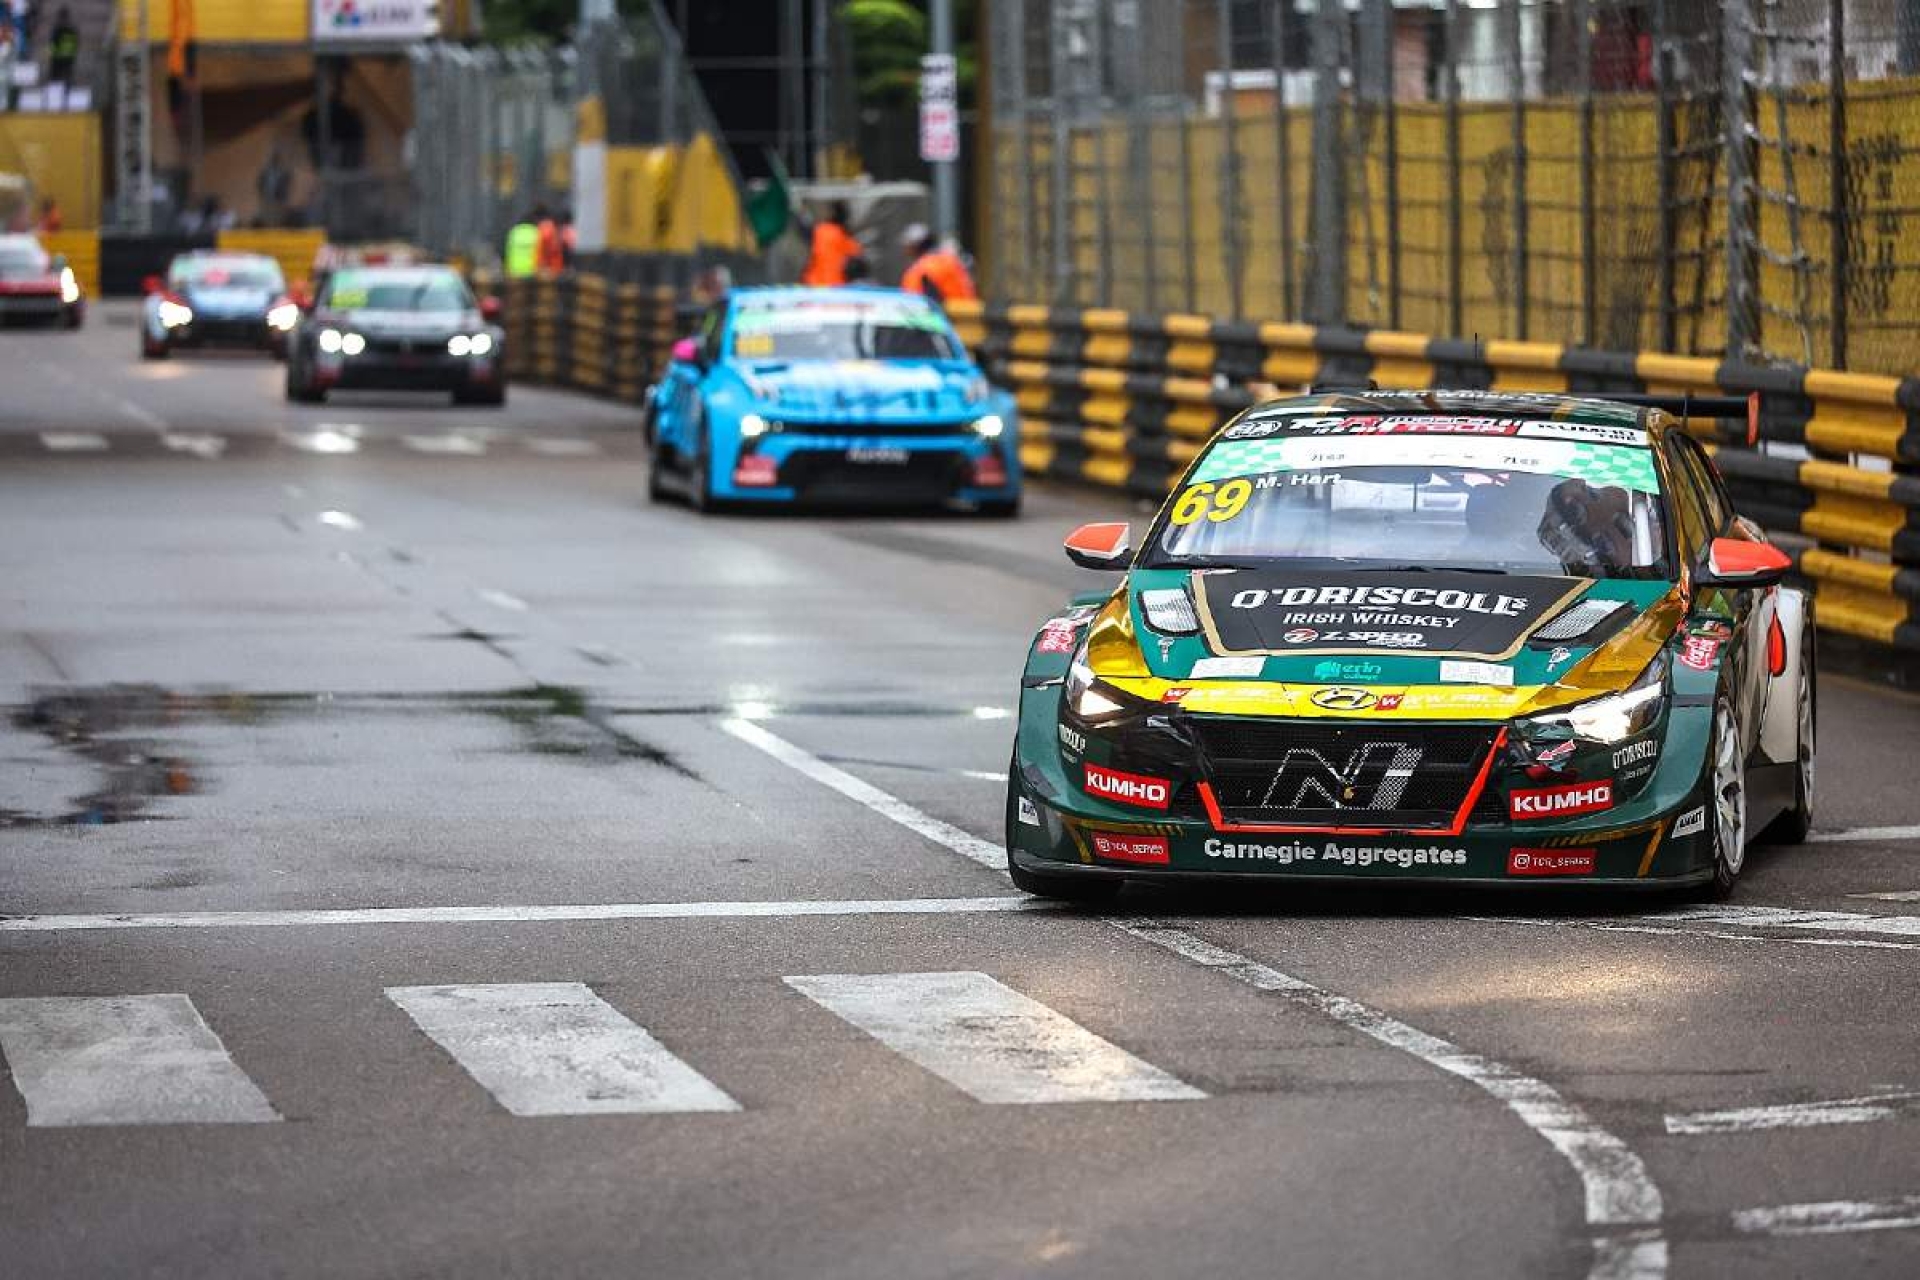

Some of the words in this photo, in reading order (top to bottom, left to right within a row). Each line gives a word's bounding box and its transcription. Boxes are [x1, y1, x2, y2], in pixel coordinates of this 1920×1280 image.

[1256, 475, 1282, 489] M.
[1290, 472, 1342, 486] Hart
[1171, 478, 1252, 526] 69
[1283, 612, 1346, 625] IRISH
[1351, 612, 1460, 628] WHISKEY
[1341, 661, 1382, 674] erin
[1086, 771, 1167, 802] KUMHO
[1514, 786, 1611, 812] KUMHO
[1203, 839, 1317, 865] Carnegie
[1322, 842, 1467, 868] Aggregates
